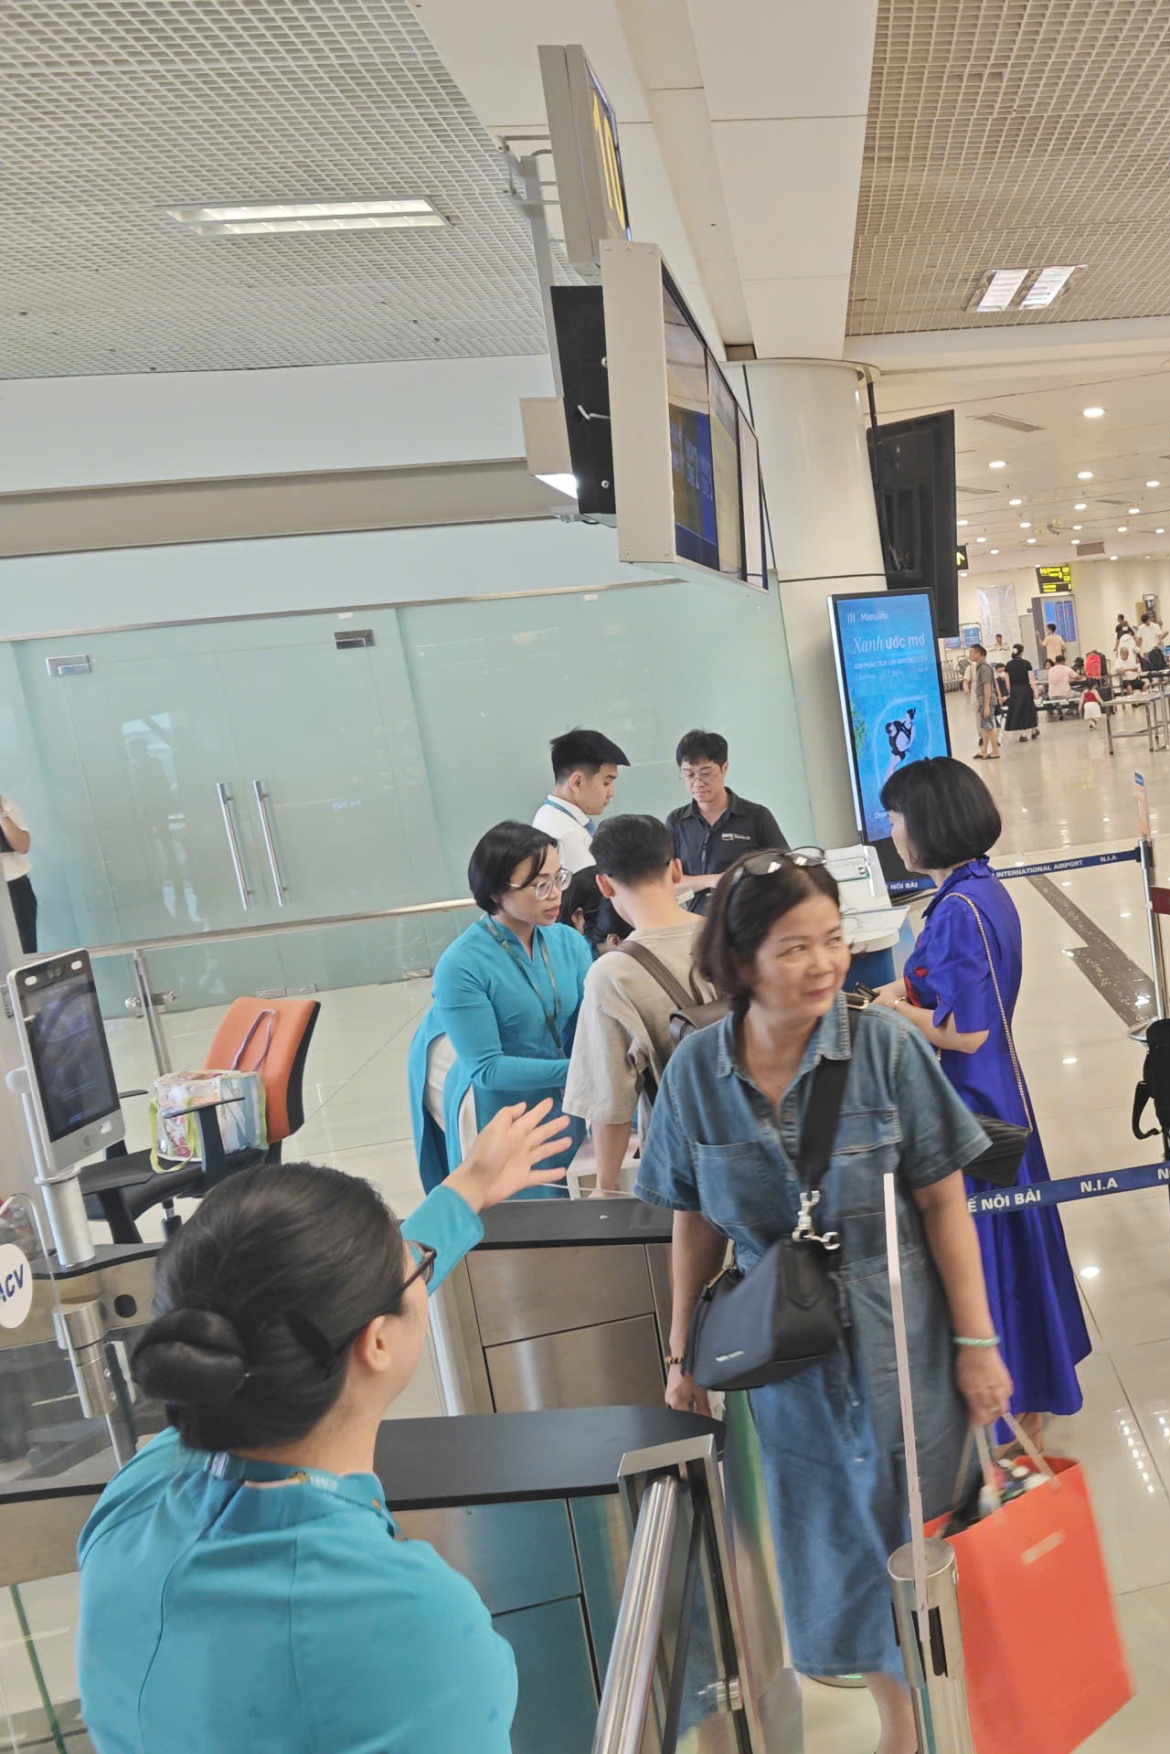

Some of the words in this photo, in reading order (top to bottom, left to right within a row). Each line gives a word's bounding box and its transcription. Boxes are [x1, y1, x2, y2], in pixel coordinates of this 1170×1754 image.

[853, 636, 883, 654] Xanh
[908, 634, 925, 646] mơ
[996, 865, 1052, 878] INTERNATIONAL
[1054, 860, 1083, 870] AIRPORT
[1100, 854, 1118, 862] N.I.A
[968, 1195, 978, 1213] Ế
[982, 1194, 1010, 1212] NỘI
[1014, 1188, 1042, 1206] BÀI
[1080, 1177, 1118, 1193] N.I.A
